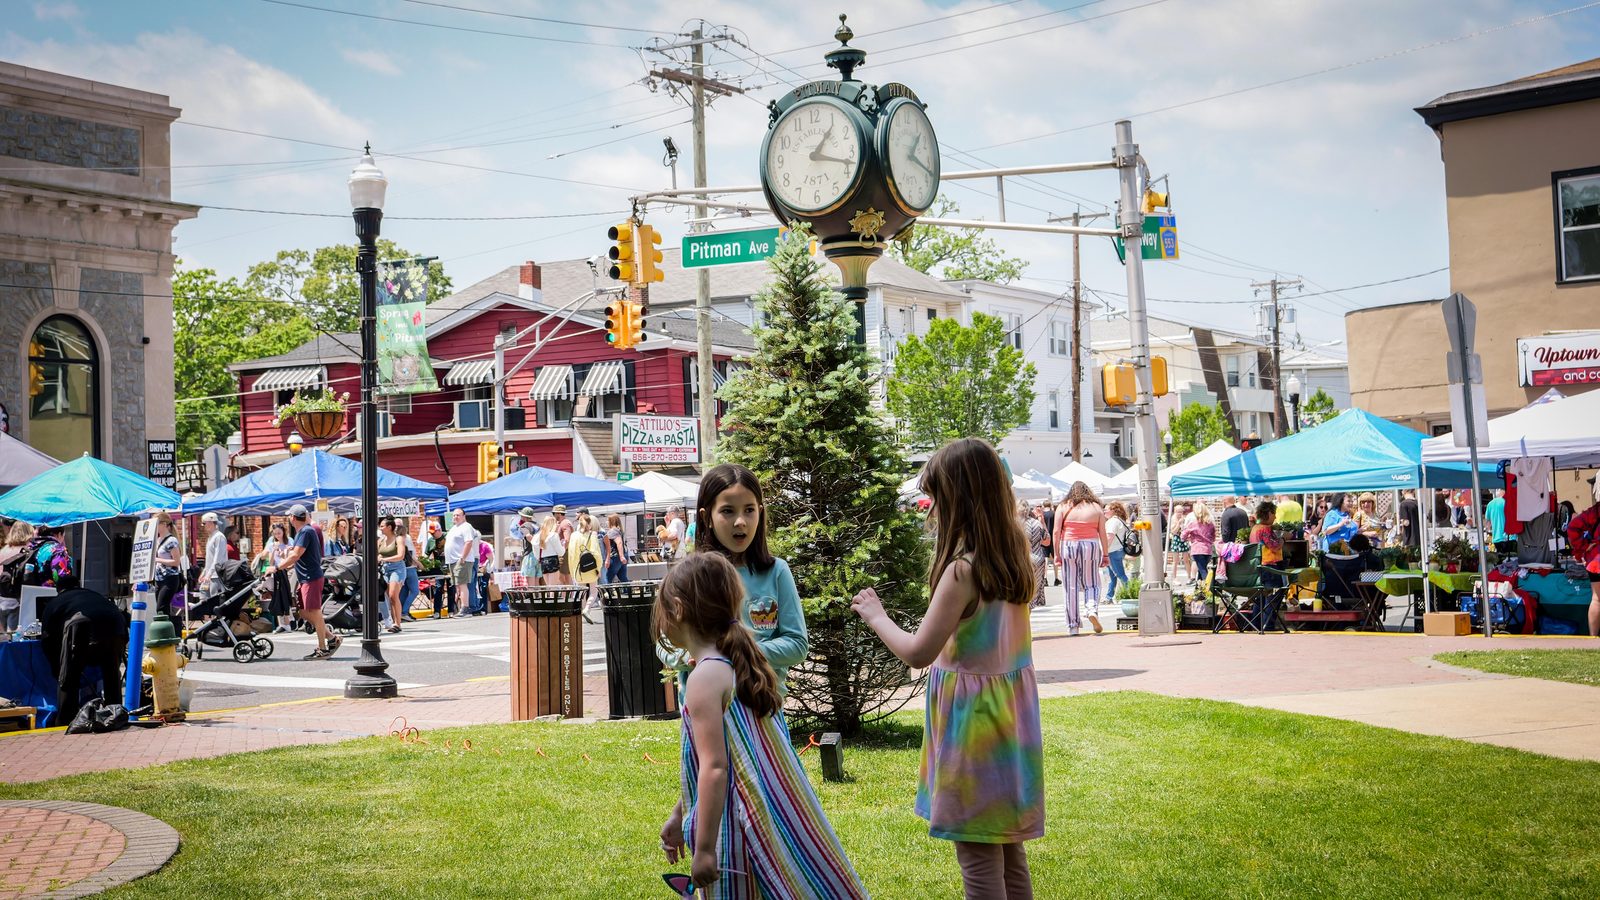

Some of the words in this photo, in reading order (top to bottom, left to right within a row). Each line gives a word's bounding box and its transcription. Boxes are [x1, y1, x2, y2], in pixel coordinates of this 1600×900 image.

[794, 82, 842, 100] PITMAN
[809, 108, 820, 124] 12
[794, 117, 802, 132] 11
[843, 125, 849, 140] 2
[780, 135, 791, 150] 10
[849, 145, 855, 158] 3
[778, 155, 784, 168] 9
[783, 173, 790, 187] 8
[803, 173, 829, 185] 1871
[795, 187, 802, 201] 7
[832, 182, 839, 195] 5
[814, 190, 820, 203] 6
[690, 241, 740, 260] Pitman
[748, 240, 769, 255] Ave
[1534, 346, 1600, 368] Uptown
[1563, 370, 1586, 380] and
[639, 418, 681, 431] ATTILIO'S
[622, 422, 655, 445] PIZZA
[664, 426, 696, 446] PASTA
[150, 443, 174, 452] DRIVE-IN
